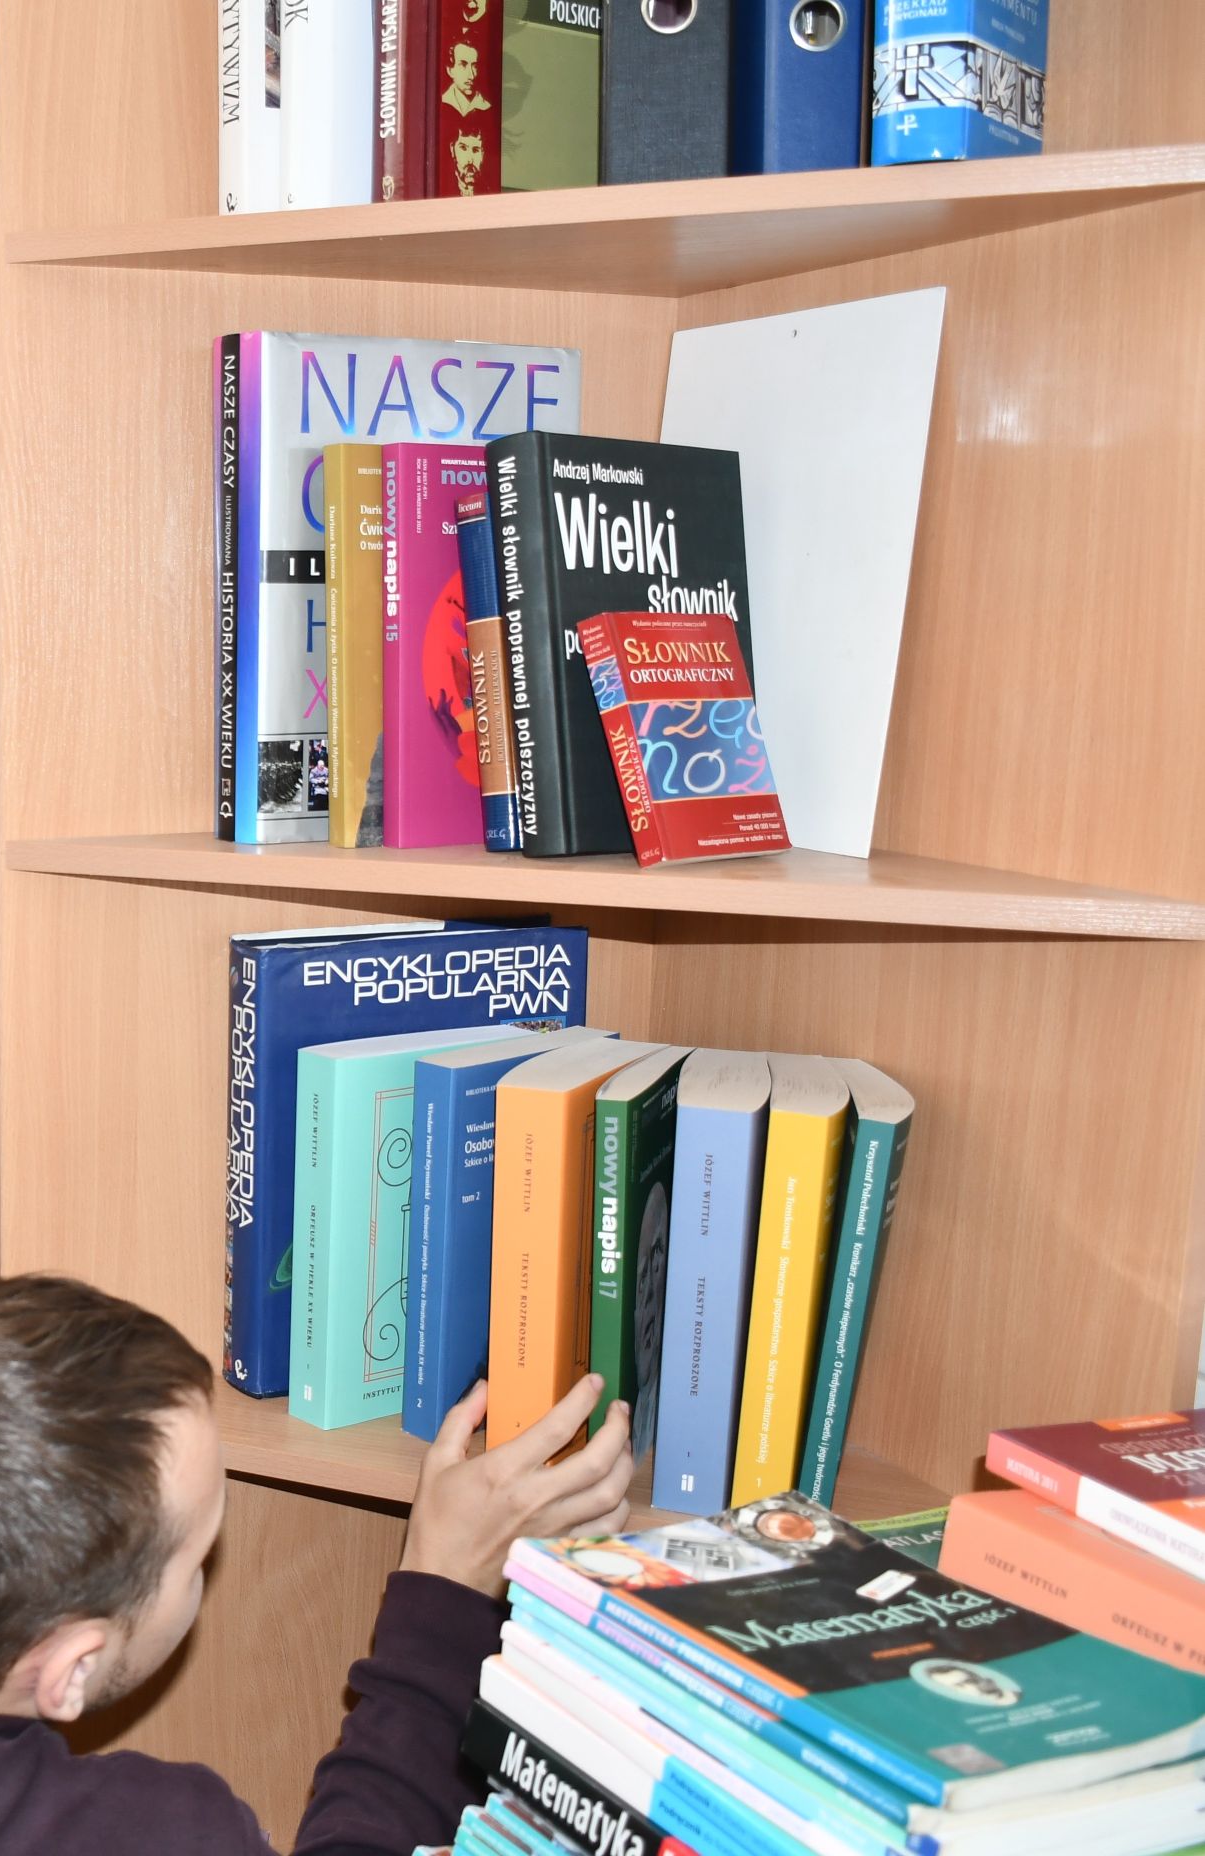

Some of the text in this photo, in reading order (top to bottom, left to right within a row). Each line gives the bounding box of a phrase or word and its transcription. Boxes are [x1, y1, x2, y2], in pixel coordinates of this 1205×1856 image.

[380, 59, 396, 139] SŁOWNIK
[300, 350, 562, 443] NASZE
[553, 458, 644, 486] Andrzej Markowski
[458, 500, 482, 514] liceum
[553, 491, 679, 579] Wielki
[220, 355, 236, 769] NASZE CZASY ILUSTROWANA HISTORIA XX WIEKU
[647, 575, 739, 622] słownik
[385, 624, 398, 642] 15
[496, 456, 538, 836] Wielki słownik poprawnej polszczyzny
[623, 637, 732, 665] SŁOWNIK
[629, 667, 735, 684] ORTOGRAFICZNY
[472, 649, 491, 764] SŁOWNIK
[609, 724, 649, 833] SŁOWNIK
[303, 943, 571, 987] ENCYKLOPEDIA
[354, 967, 571, 1006] POPULARNA
[488, 989, 569, 1018] PWN
[228, 1003, 243, 1224] POPULARNA
[239, 957, 256, 1230] ENCYKLOPEDIA
[312, 1093, 320, 1123] JÓZEF
[425, 1102, 434, 1134] Wiesław
[311, 1127, 319, 1169] WITTLIN
[425, 1134, 434, 1158] Paweł
[463, 1157, 482, 1168] Szkice
[864, 1139, 879, 1181] Krzysztof
[423, 1158, 433, 1200] Szymański
[461, 1191, 480, 1204] tom 2
[855, 1181, 872, 1236] Polechoński
[517, 1132, 532, 1369] JÓZEF WITTLIN TEKSTY ROZPROSZONE
[849, 1241, 863, 1278] Kronikarz
[598, 1281, 618, 1299] 17
[689, 1153, 713, 1397] JÓZEF WITTLIN TEKSTY ROZPROSZONE
[307, 1300, 313, 1314] XX
[756, 1175, 797, 1464] Jan Tomkowski Słoneczne gospodarstwo. Szkice literaturze polskiej
[362, 1385, 402, 1400] INSTYTUT
[825, 1368, 841, 1417] Ferdynandzie
[820, 1417, 835, 1441] Goetlu
[816, 1446, 828, 1463] jego
[1019, 1569, 1070, 1600] WITTLIN
[706, 1588, 994, 1653] Matematyka
[499, 1731, 645, 1856] Matematyka
